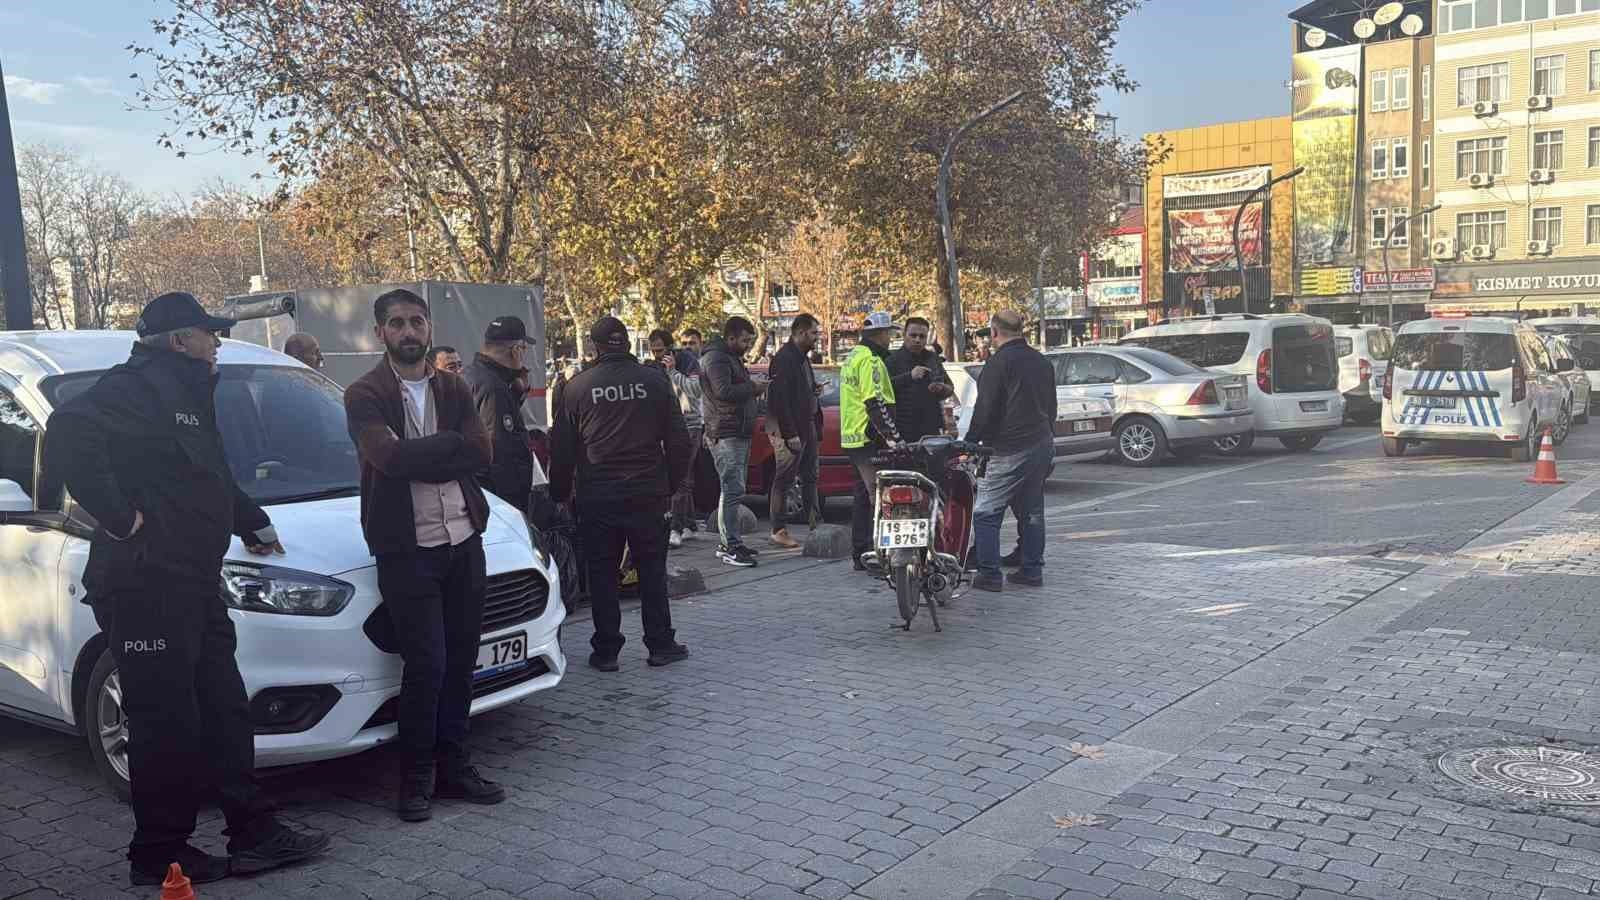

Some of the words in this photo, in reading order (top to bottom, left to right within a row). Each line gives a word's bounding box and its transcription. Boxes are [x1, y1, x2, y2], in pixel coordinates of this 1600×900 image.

[1477, 276, 1543, 291] KISMET
[894, 533, 918, 545] 876
[492, 638, 522, 666] 179
